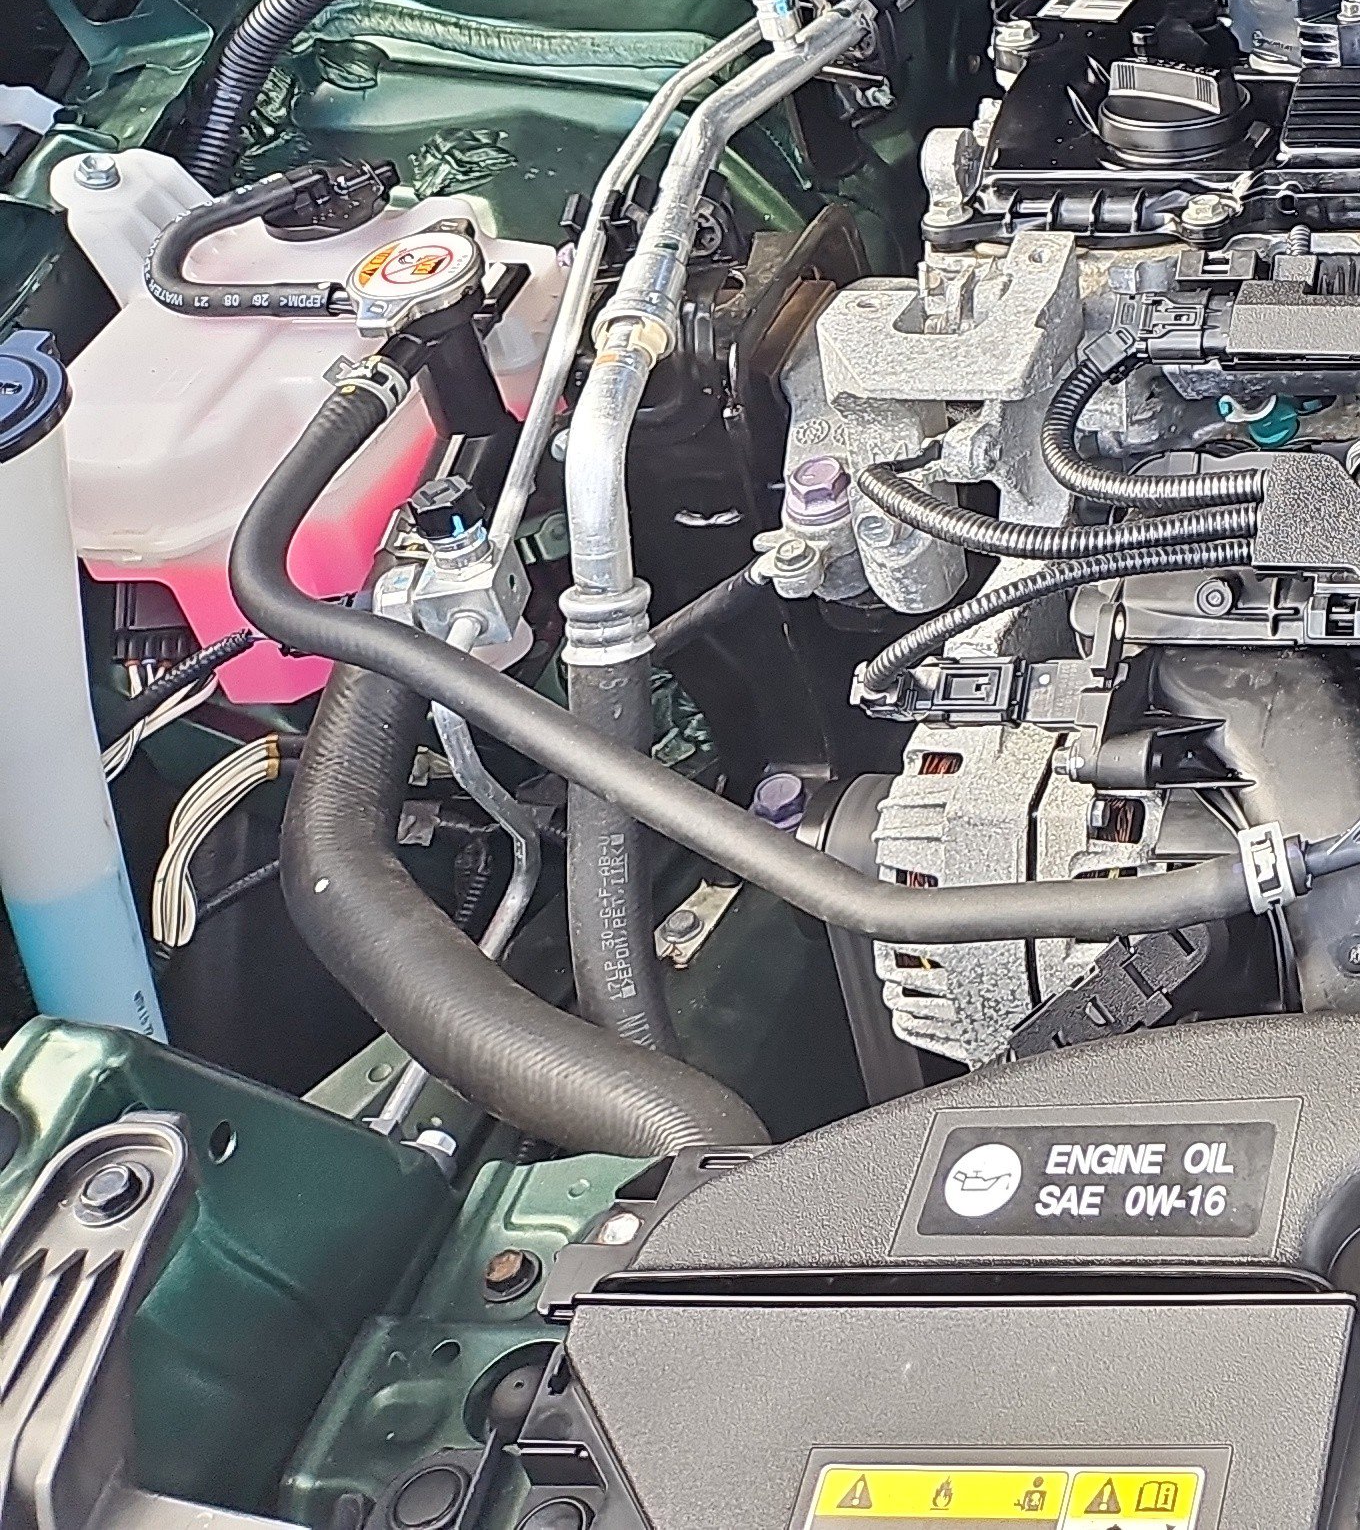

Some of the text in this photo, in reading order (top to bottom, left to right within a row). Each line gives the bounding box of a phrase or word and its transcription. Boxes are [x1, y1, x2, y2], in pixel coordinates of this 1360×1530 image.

[149, 279, 183, 306] WATER
[1044, 1143, 1237, 1176] ENGINE OIL
[1033, 1183, 1229, 1218] SAE 0W-16
